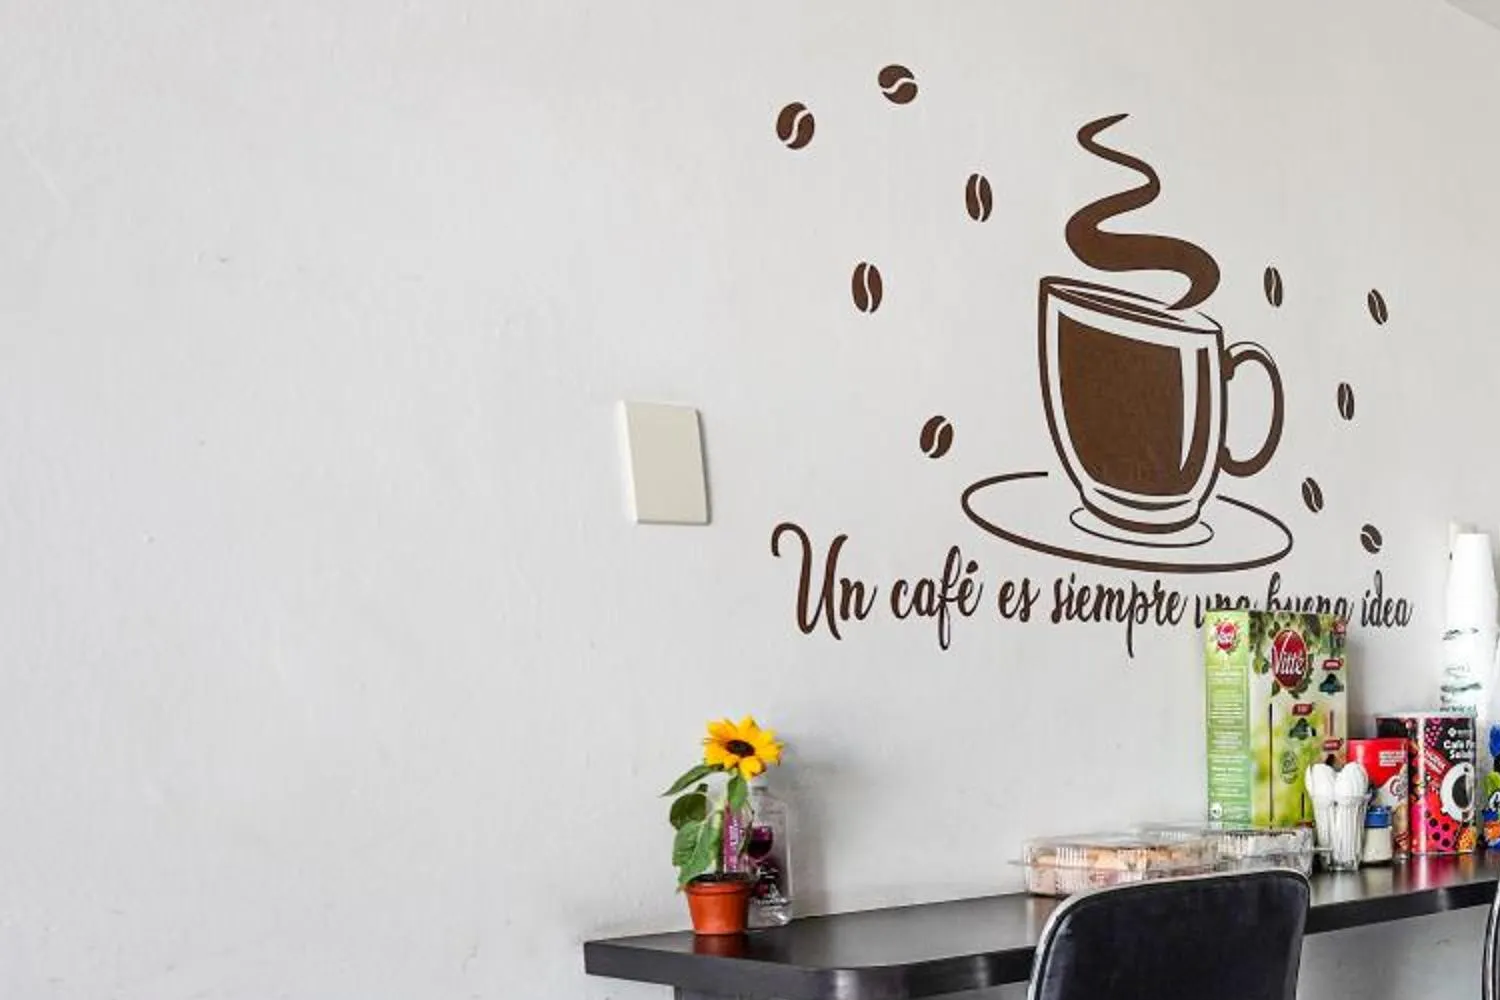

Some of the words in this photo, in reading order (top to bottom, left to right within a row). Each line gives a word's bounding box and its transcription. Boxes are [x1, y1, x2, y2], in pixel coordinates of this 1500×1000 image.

[771, 522, 878, 640] Un
[890, 545, 983, 650] café
[998, 577, 1040, 622] es
[1051, 572, 1188, 658] siempre
[1361, 569, 1413, 627] idea
